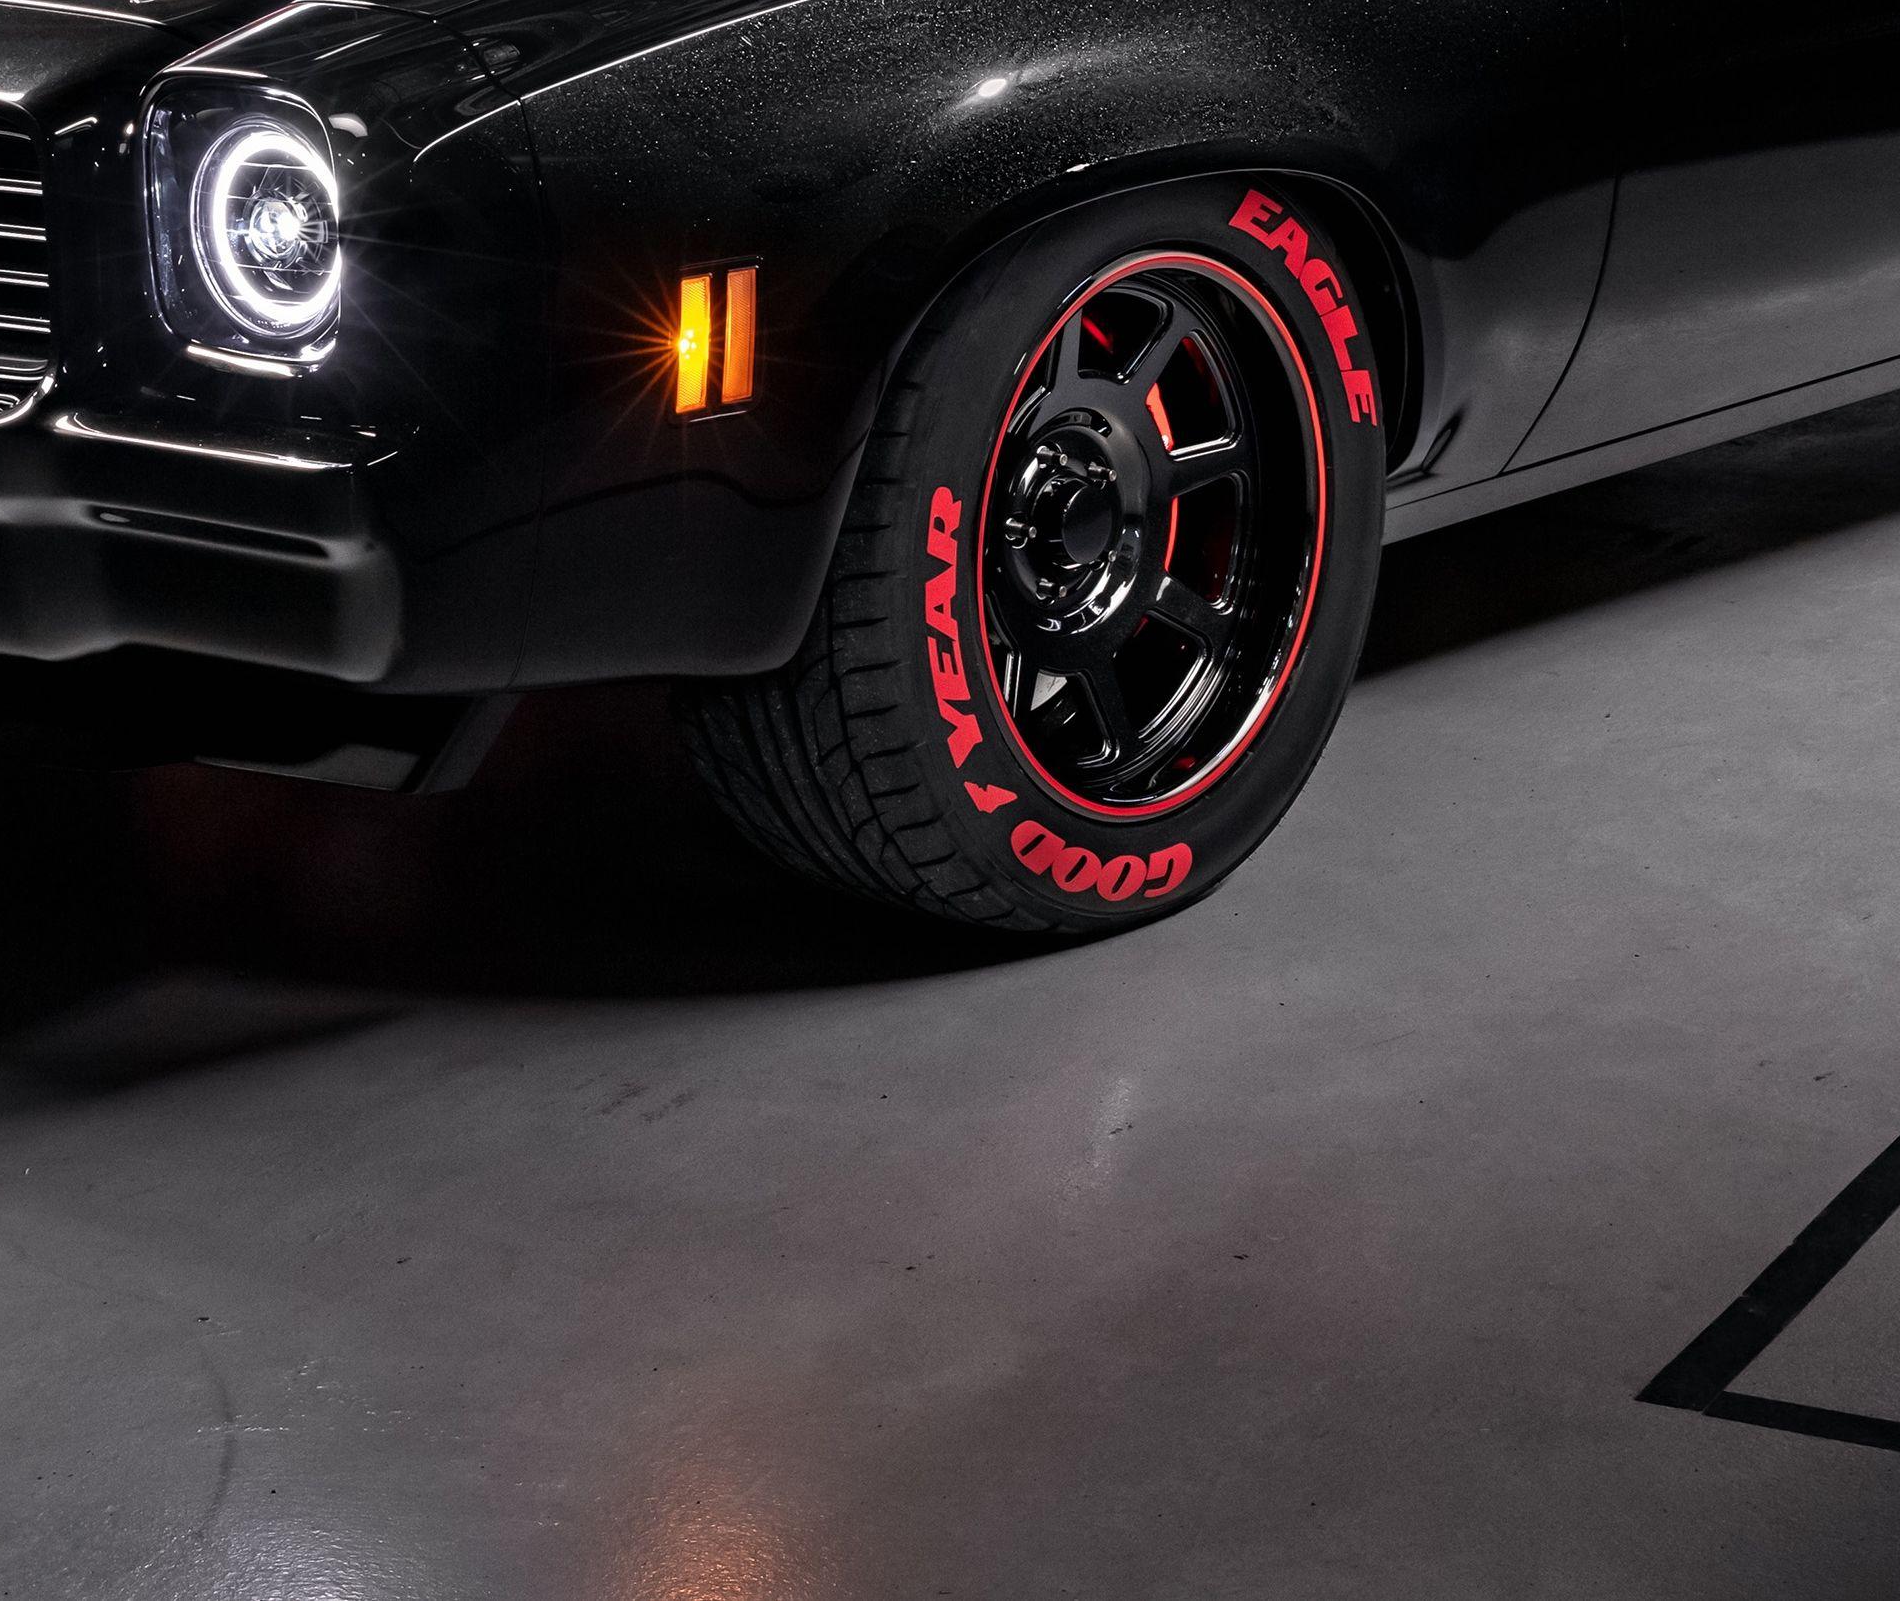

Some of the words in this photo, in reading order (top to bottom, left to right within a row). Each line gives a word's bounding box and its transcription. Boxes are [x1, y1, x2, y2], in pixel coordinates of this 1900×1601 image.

[1229, 188, 1378, 427] EAGLE
[918, 484, 983, 769] YEAR
[1010, 819, 1193, 902] GOOD
